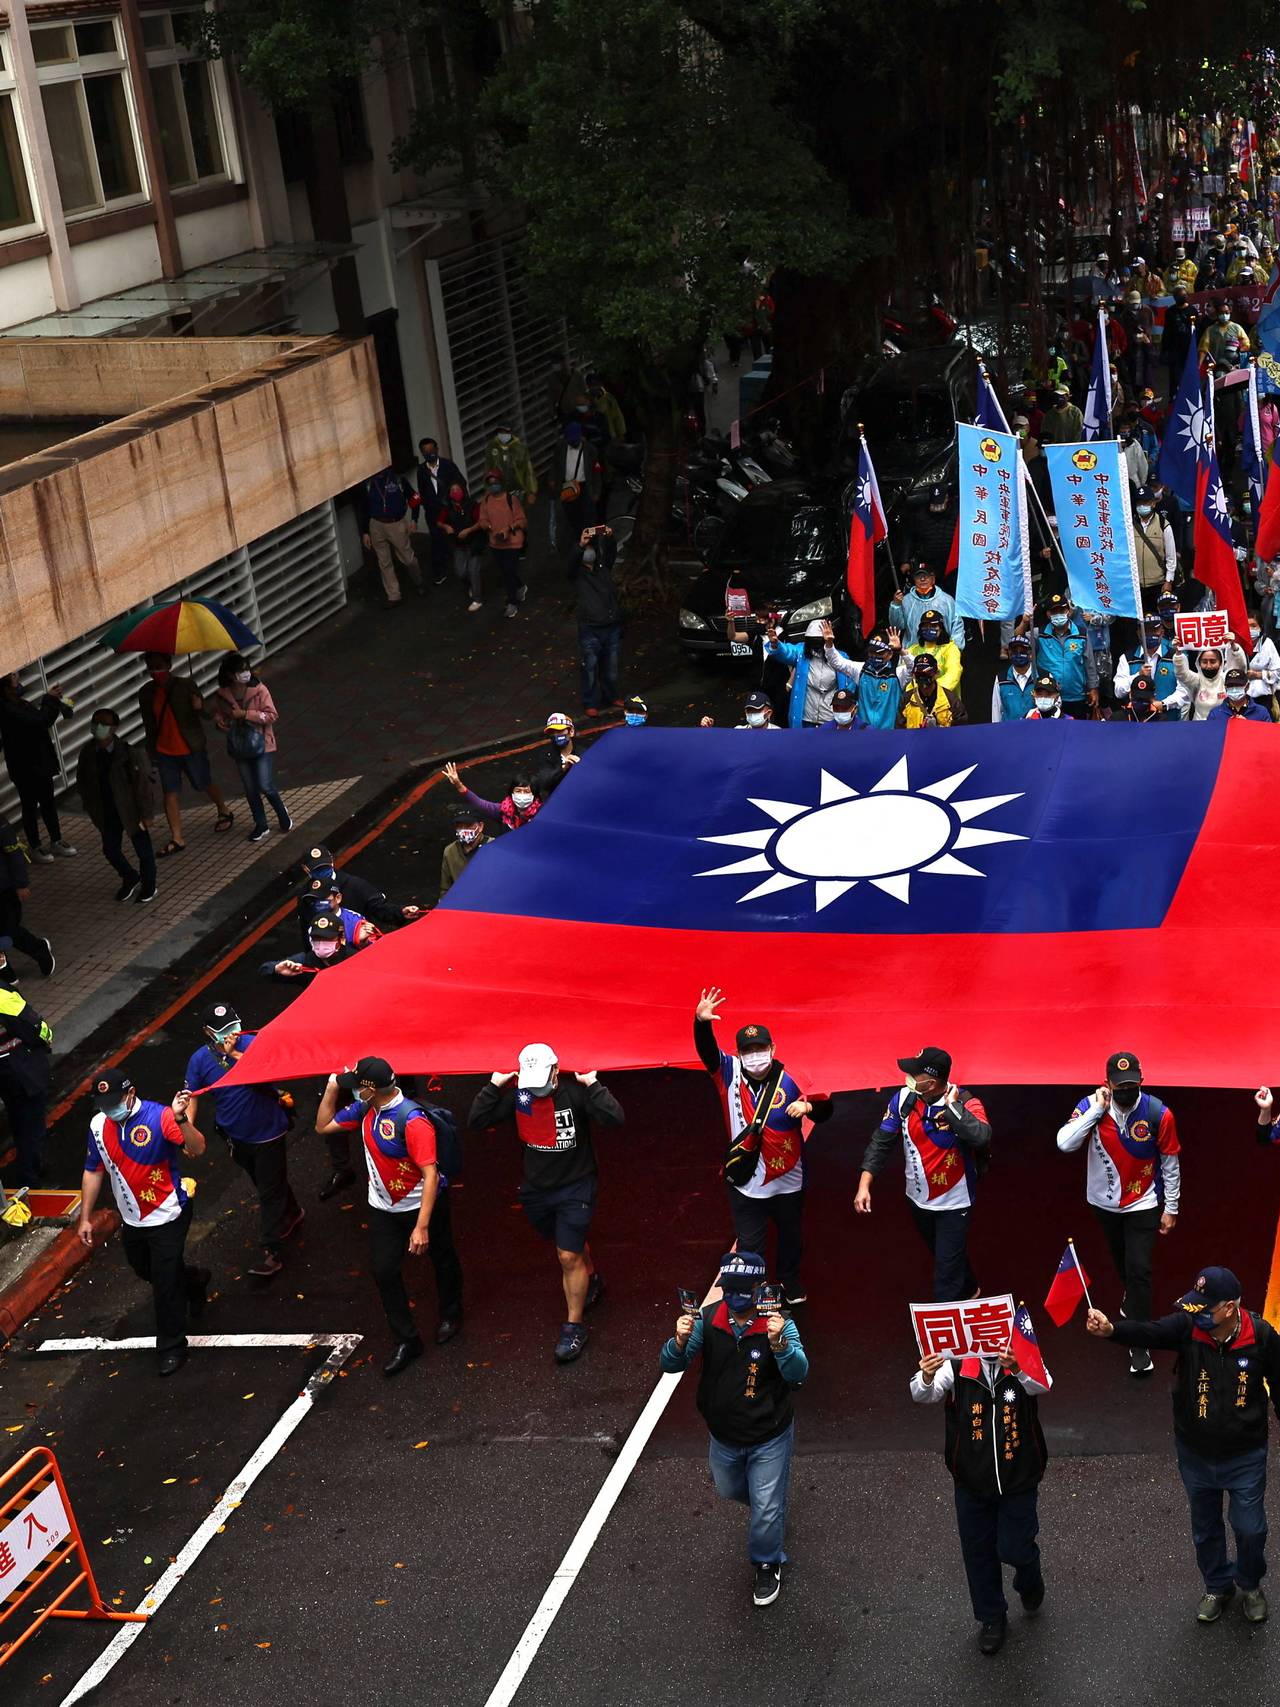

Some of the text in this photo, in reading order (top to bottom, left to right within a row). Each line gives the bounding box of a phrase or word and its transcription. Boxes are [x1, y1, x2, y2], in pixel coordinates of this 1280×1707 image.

[1176, 612, 1227, 647] 同意
[914, 1303, 1013, 1359] 同意
[1197, 1369, 1210, 1419] 主任委員
[46, 1530, 60, 1547] 109
